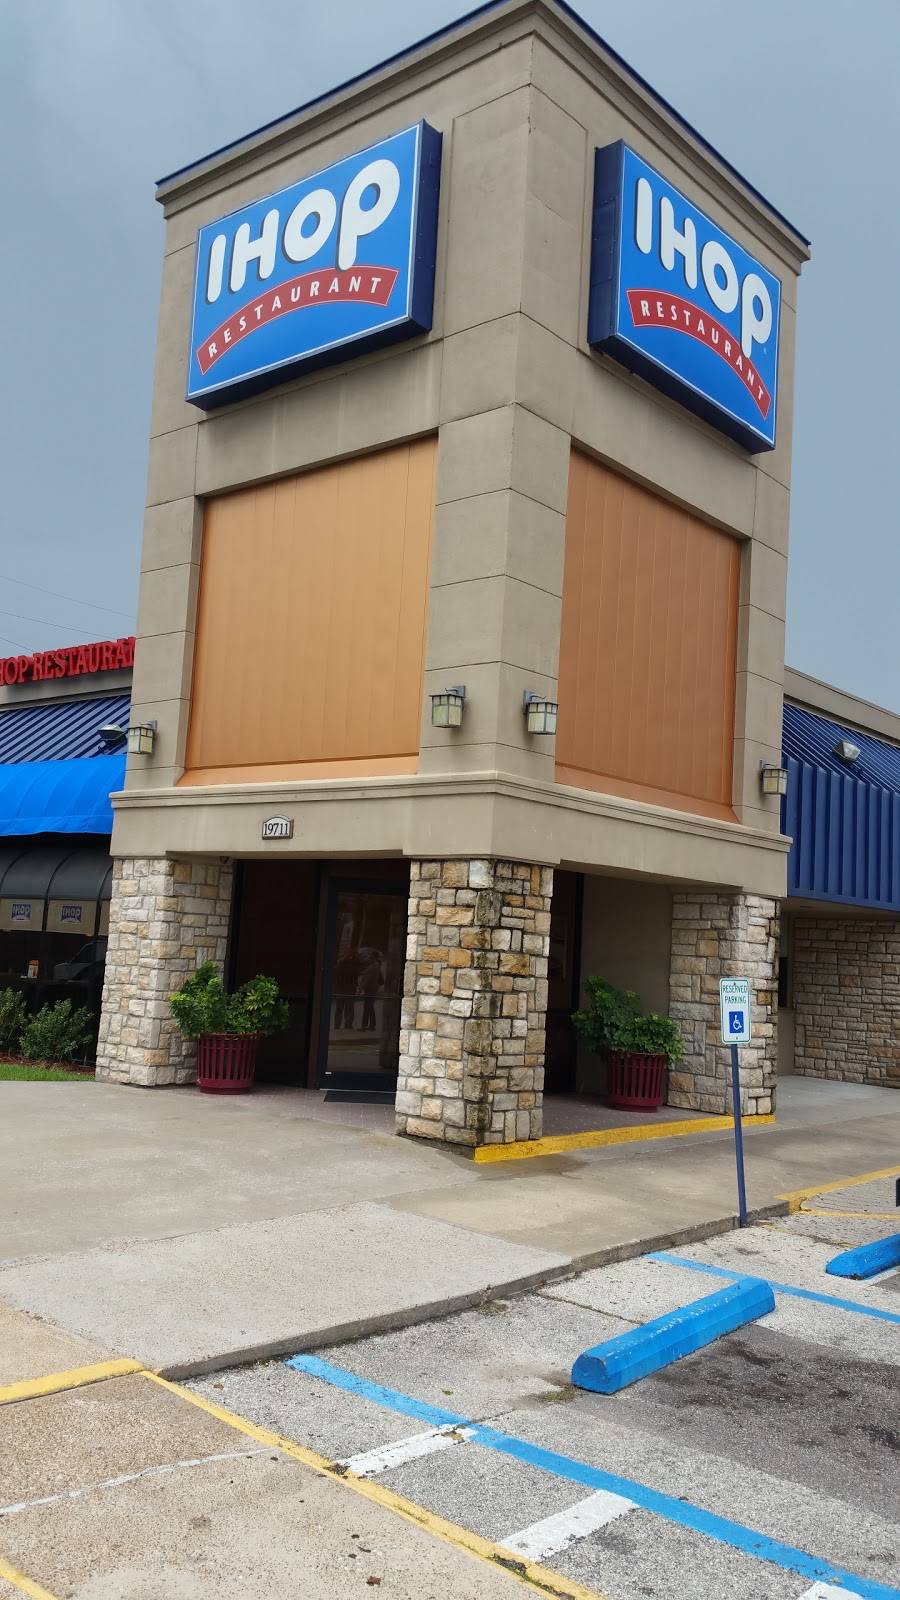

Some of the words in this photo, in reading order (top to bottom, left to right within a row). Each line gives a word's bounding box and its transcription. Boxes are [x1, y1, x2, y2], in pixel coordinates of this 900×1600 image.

[207, 158, 400, 303] IHOP
[635, 177, 772, 358] IHOP
[208, 276, 382, 359] RESTAURANT
[641, 300, 764, 401] RESTAURANT
[264, 823, 288, 835] 19711
[62, 907, 81, 919] IHOP
[722, 985, 747, 993] RESERVED
[725, 996, 746, 1004] PARKING
